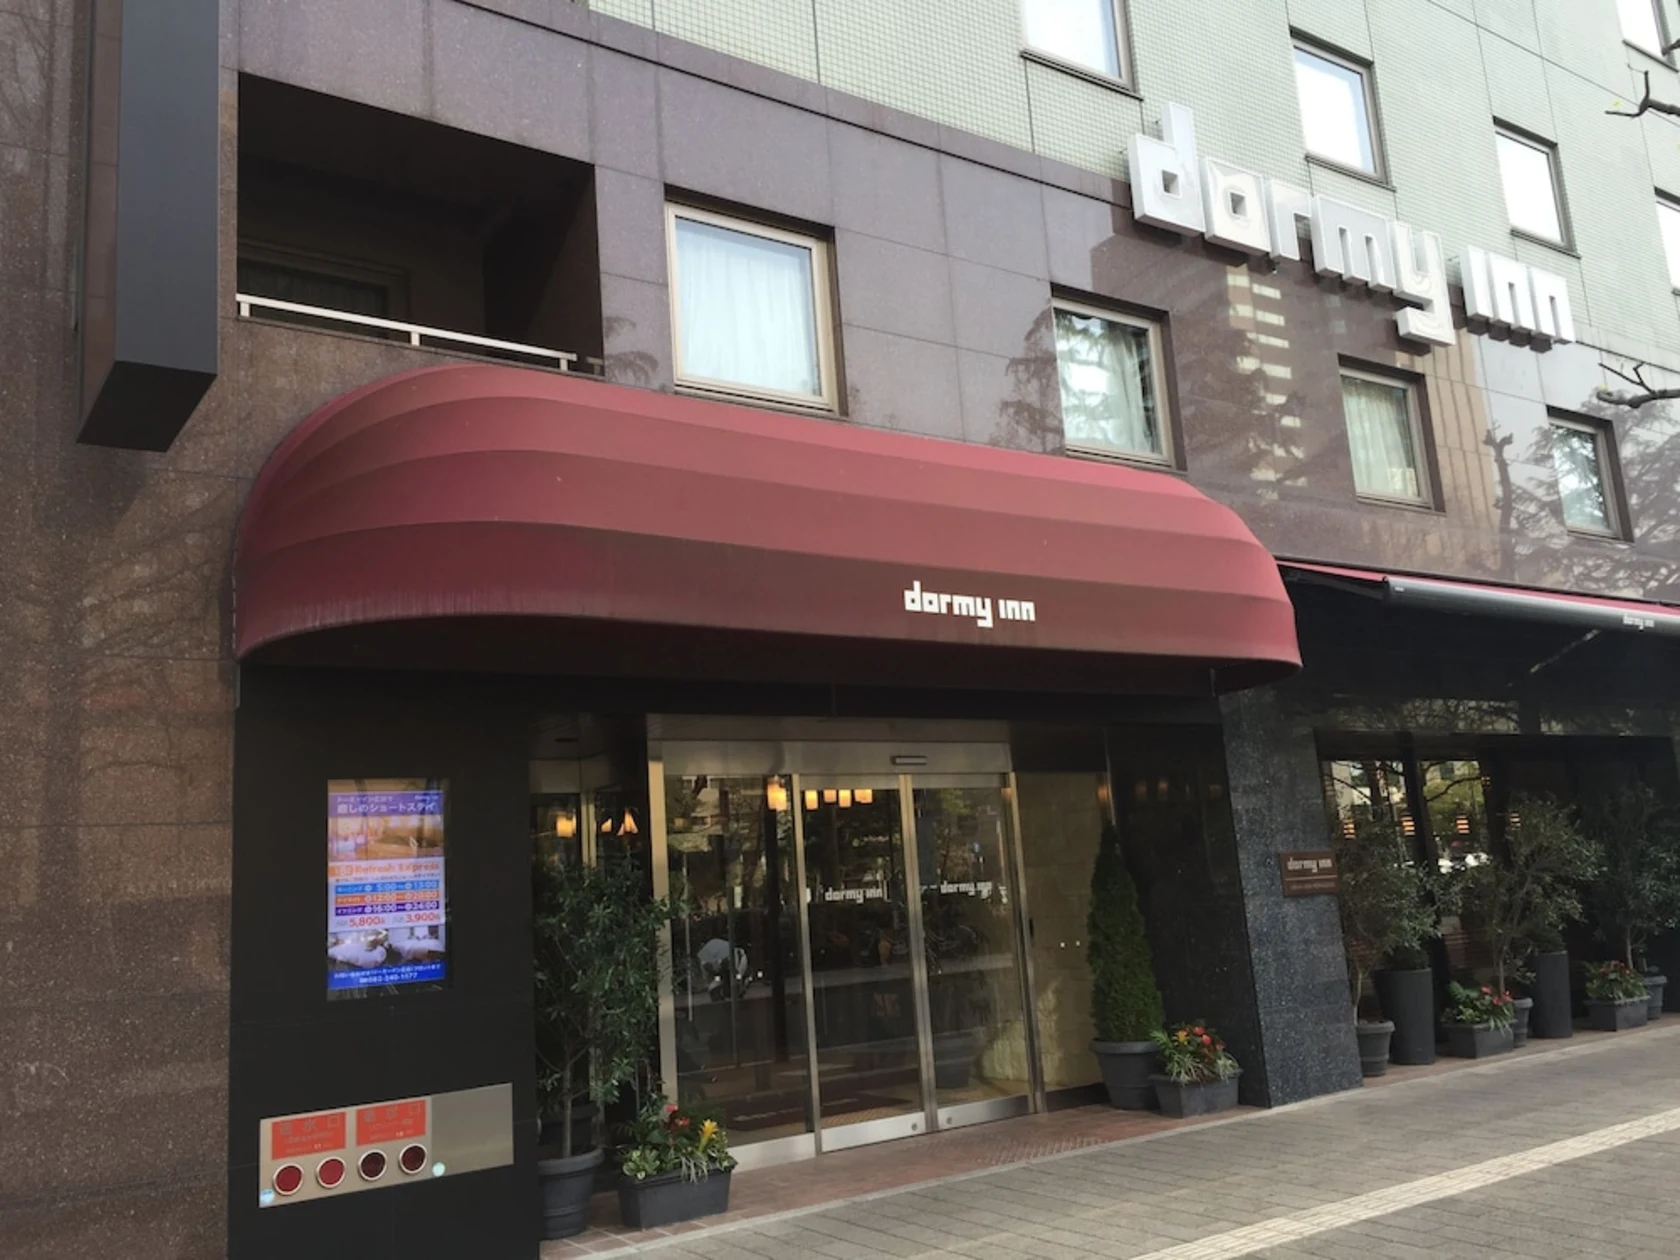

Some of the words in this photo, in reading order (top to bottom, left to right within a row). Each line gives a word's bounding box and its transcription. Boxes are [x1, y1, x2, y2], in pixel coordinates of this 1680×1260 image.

[1127, 101, 1456, 347] dormy
[1459, 244, 1576, 344] inn
[904, 580, 993, 628] dormy
[998, 599, 1036, 622] inn
[824, 887, 864, 904] dormy
